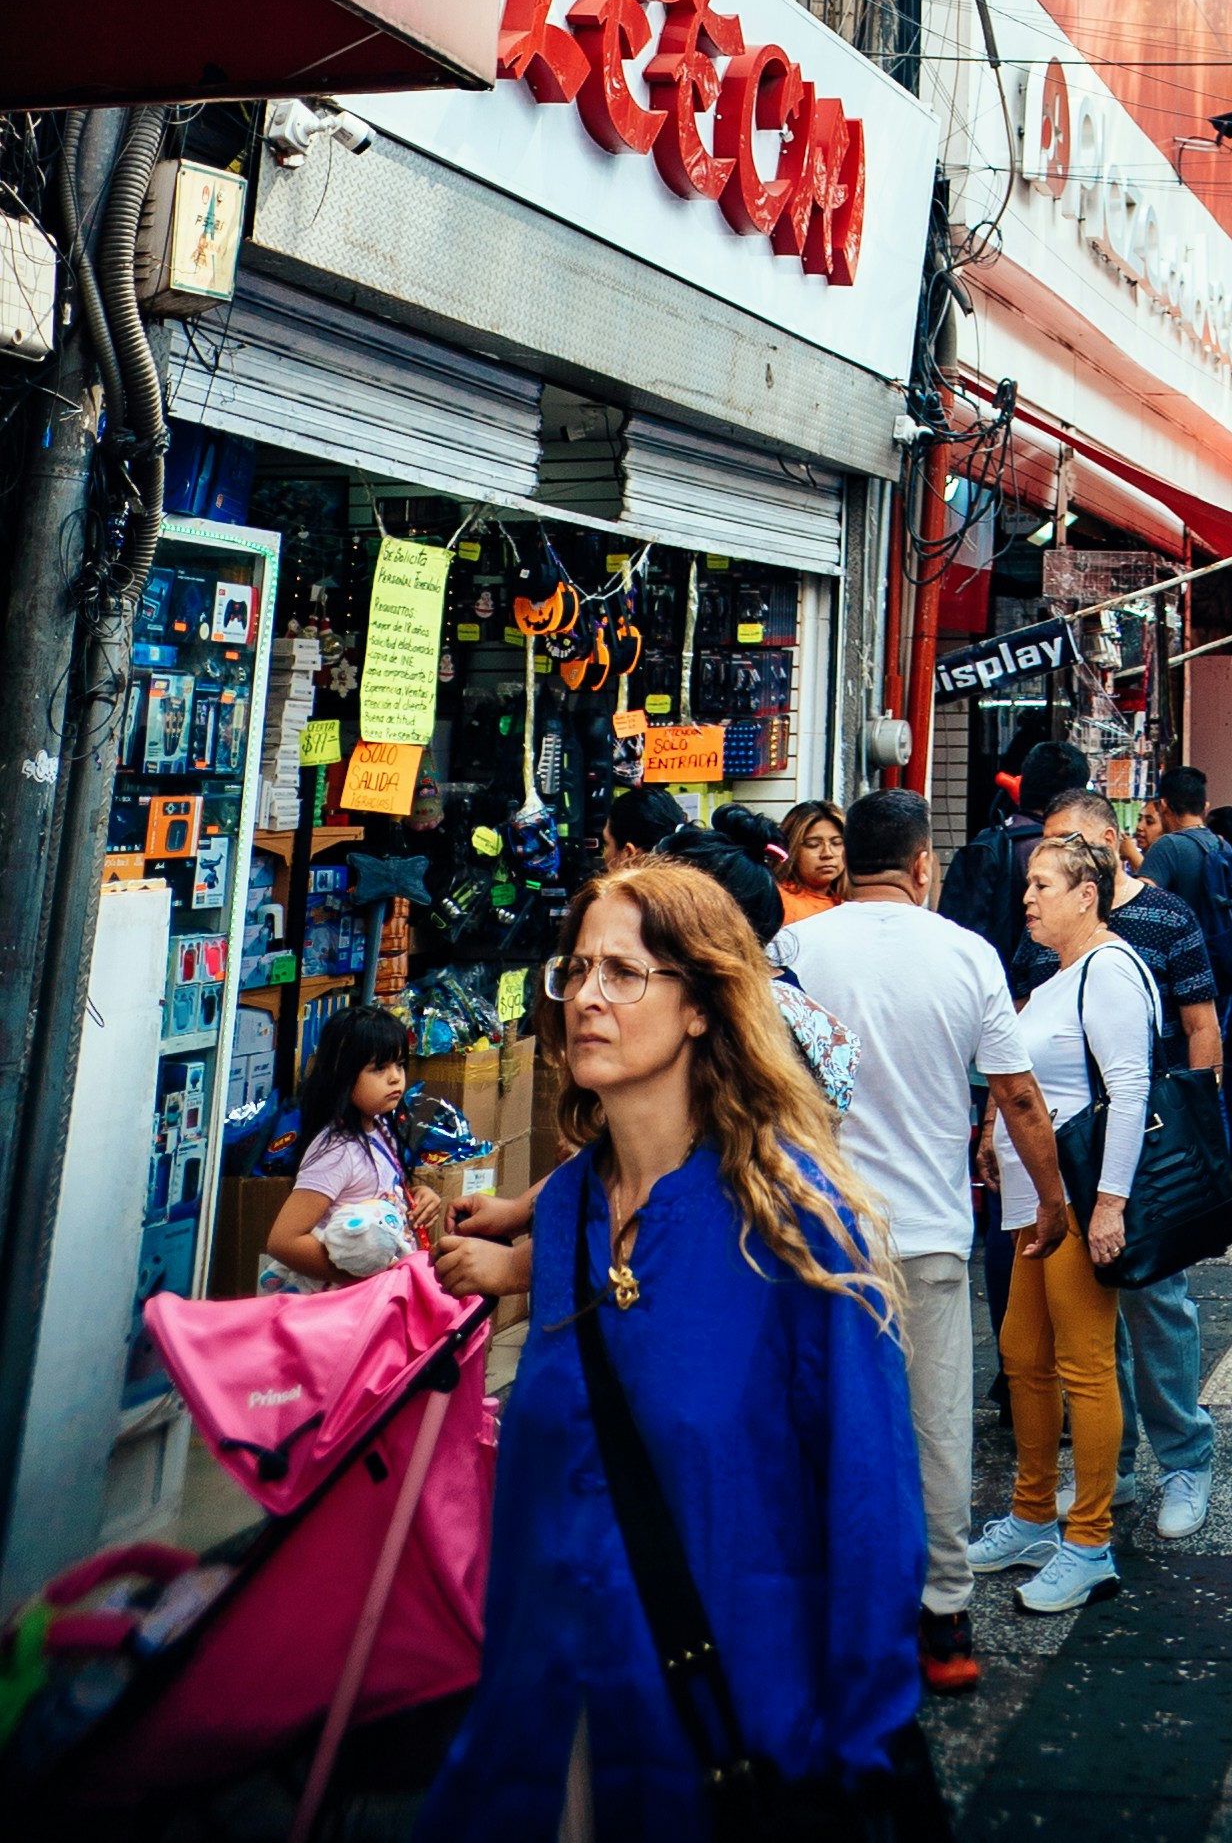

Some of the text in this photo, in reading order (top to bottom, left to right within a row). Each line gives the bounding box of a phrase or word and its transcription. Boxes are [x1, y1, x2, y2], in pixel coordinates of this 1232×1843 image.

[653, 739, 688, 755] SOLO
[647, 752, 718, 770] ENTRADA
[349, 765, 400, 792] SALIDA
